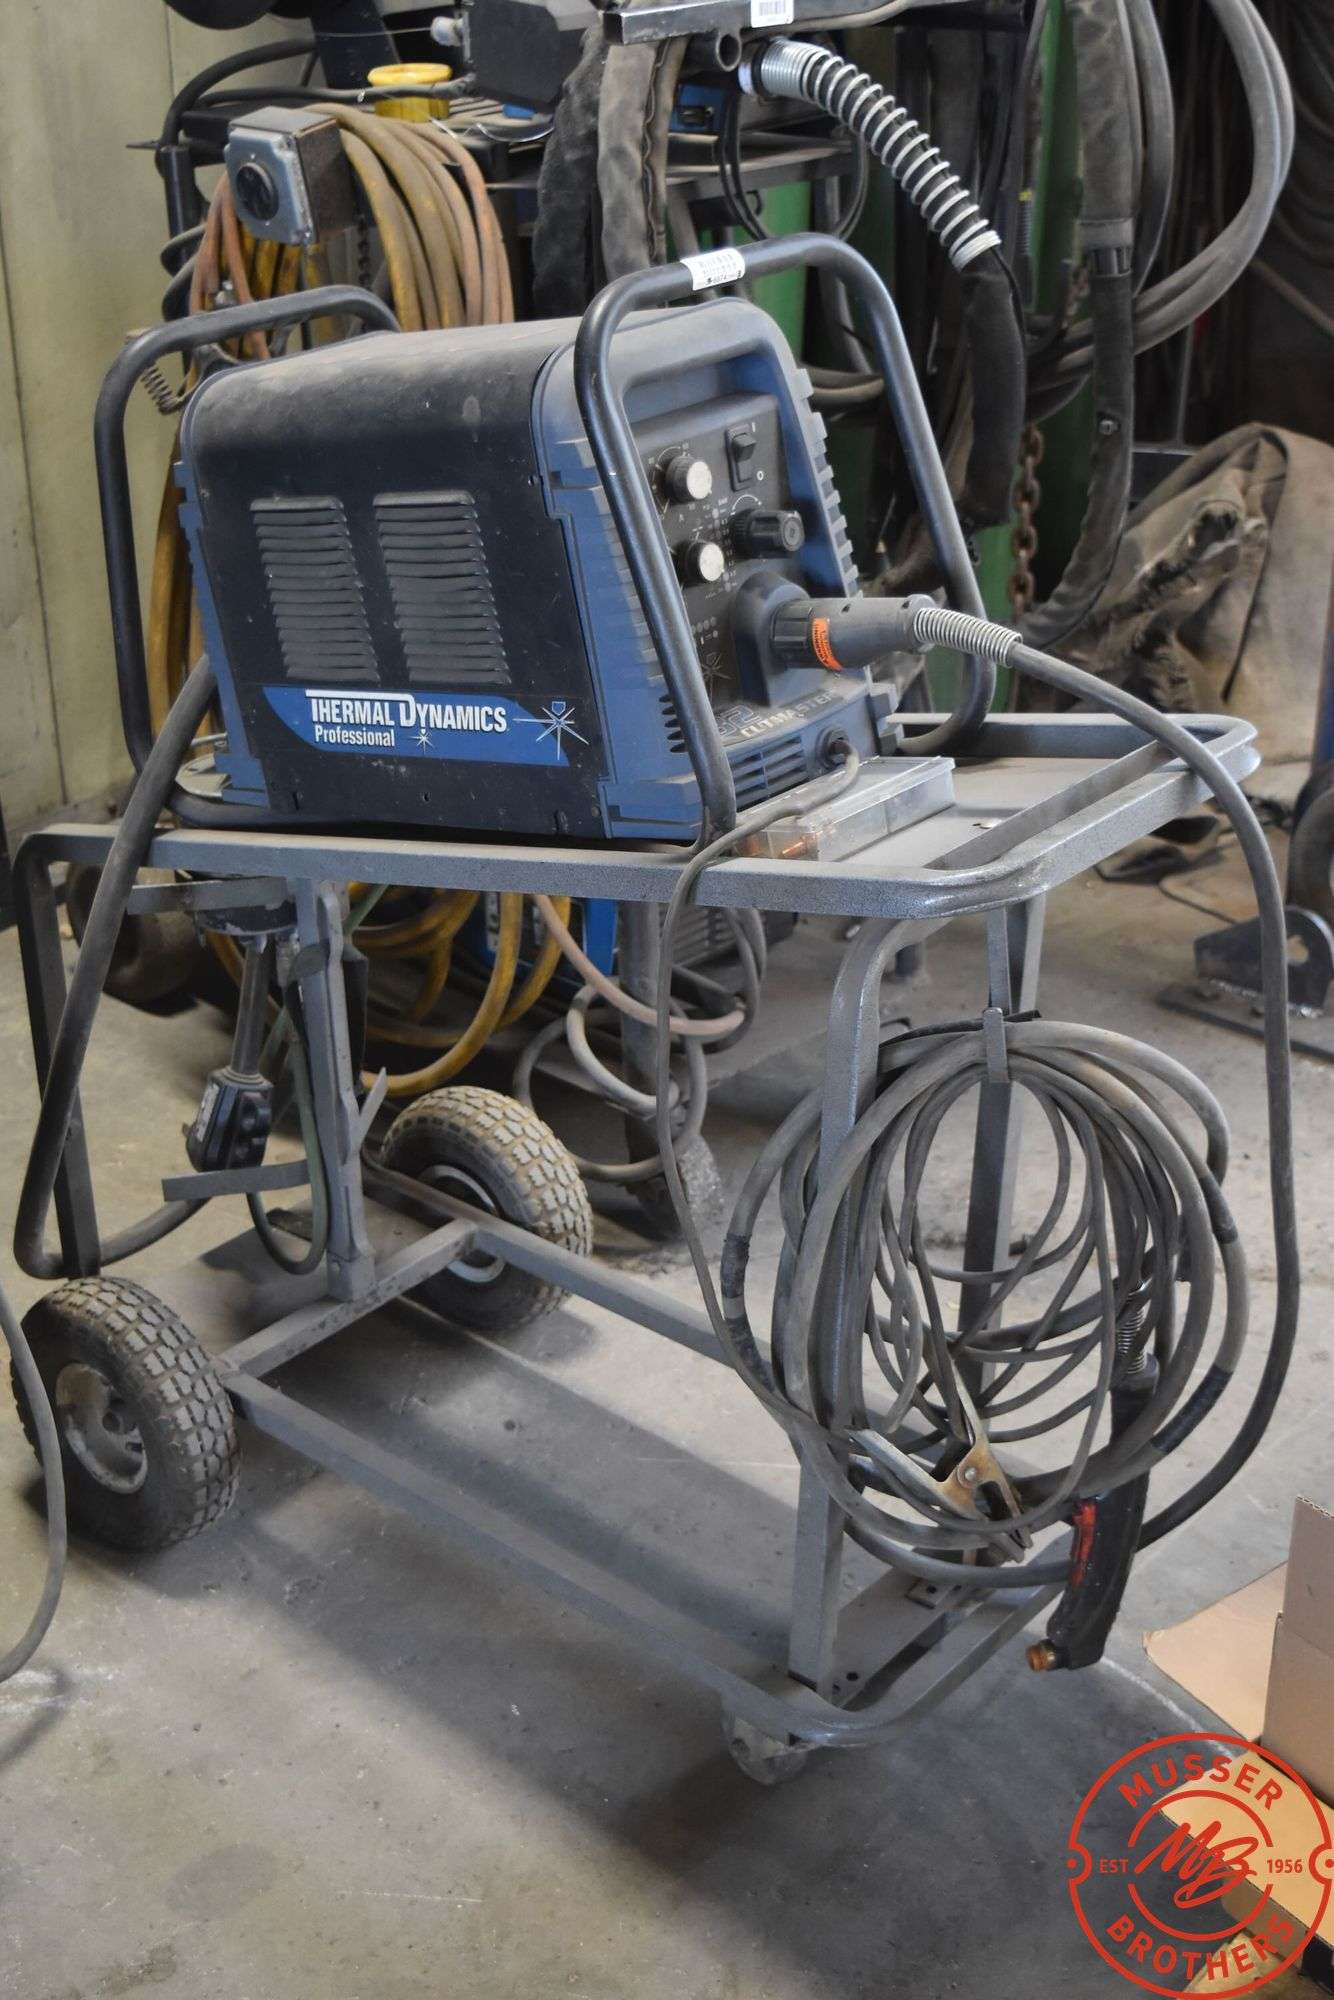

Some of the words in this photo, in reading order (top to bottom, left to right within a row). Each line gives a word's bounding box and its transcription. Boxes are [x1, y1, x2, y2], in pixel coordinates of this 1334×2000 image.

[305, 689, 395, 725] THERMAL
[398, 691, 507, 732] DYNAMICS
[314, 724, 396, 748] Professional
